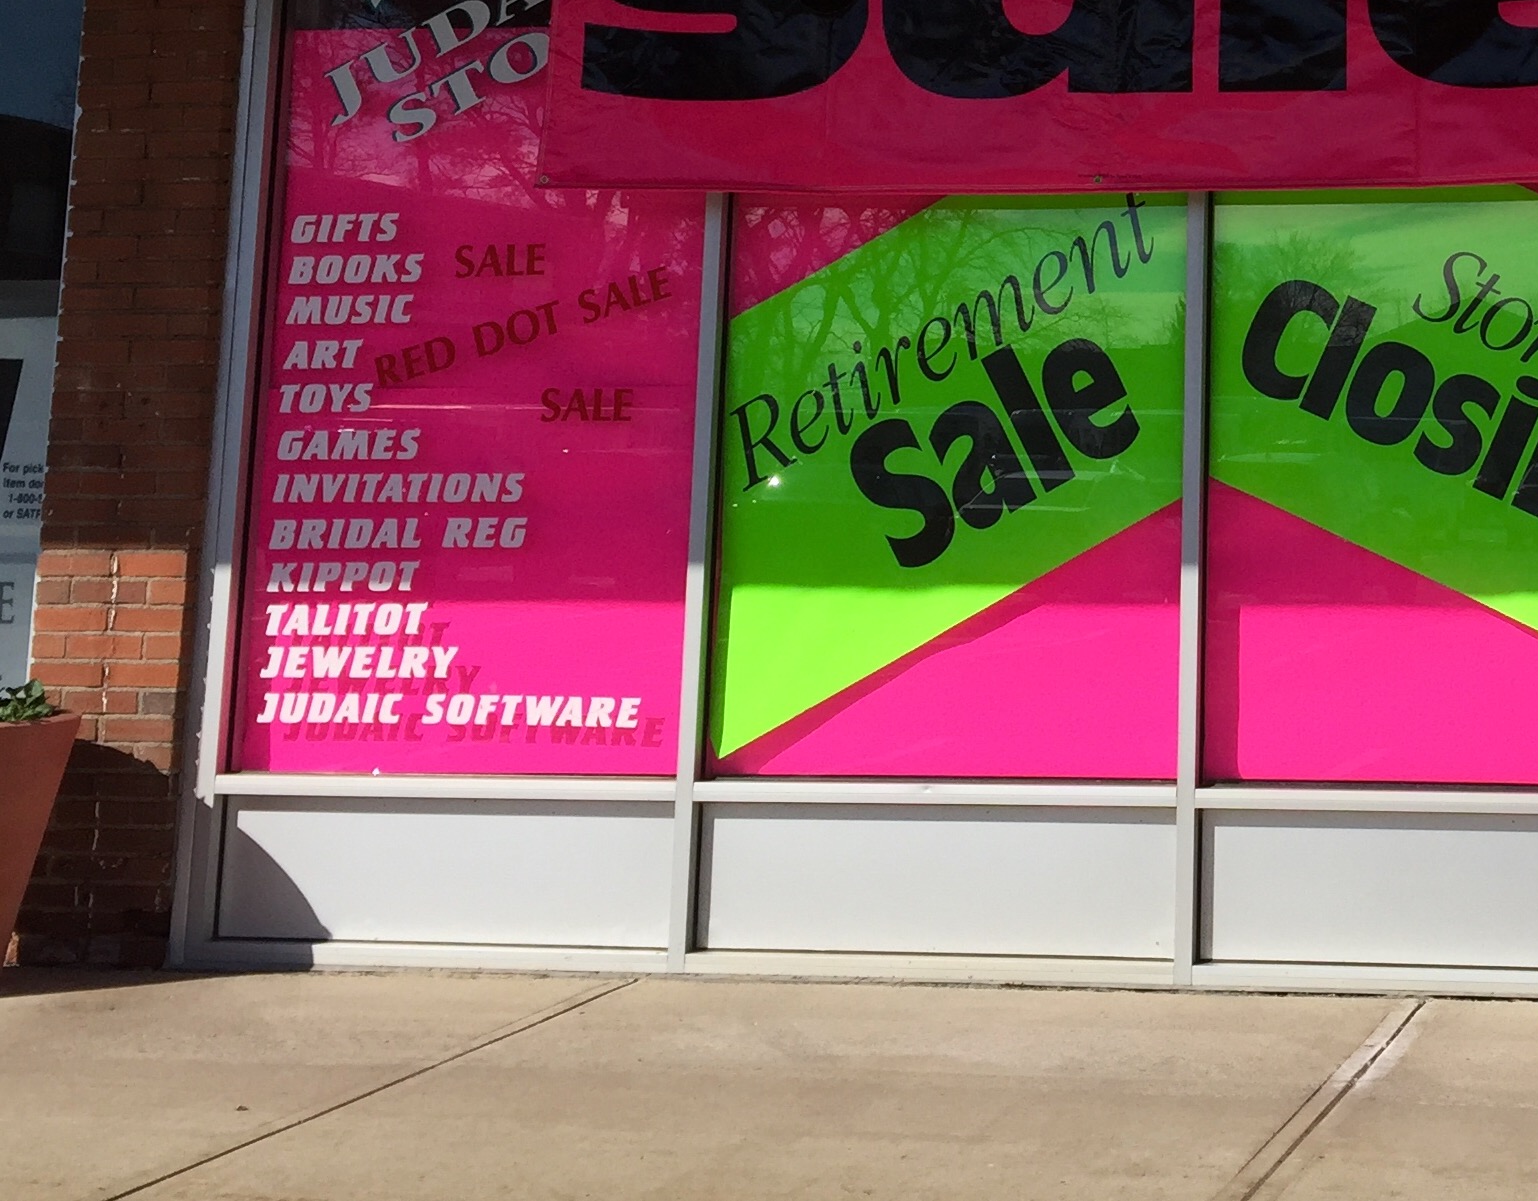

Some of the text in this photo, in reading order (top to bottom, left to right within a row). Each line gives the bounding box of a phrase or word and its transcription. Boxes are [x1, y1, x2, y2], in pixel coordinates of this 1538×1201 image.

[291, 213, 400, 244] GIFTS
[288, 253, 424, 284] BOOKS
[454, 243, 547, 279] SALE
[285, 294, 415, 325] MUSIC
[373, 266, 673, 388] RED DOT SALE
[730, 192, 1155, 492] Retirement
[282, 339, 364, 370] ART
[278, 383, 374, 413] TOYS
[539, 388, 632, 423] SALE
[276, 429, 421, 460] GAMES
[849, 337, 1141, 568] Sale
[3, 462, 20, 473] For
[272, 473, 525, 503] INVITATIONS
[268, 518, 528, 550] BRIDAL REG
[266, 561, 420, 593] KIPPOT
[264, 602, 429, 636] TALITOT
[259, 646, 459, 678] JEWELRY
[256, 693, 642, 728] JUDAIC SOFTWARE
